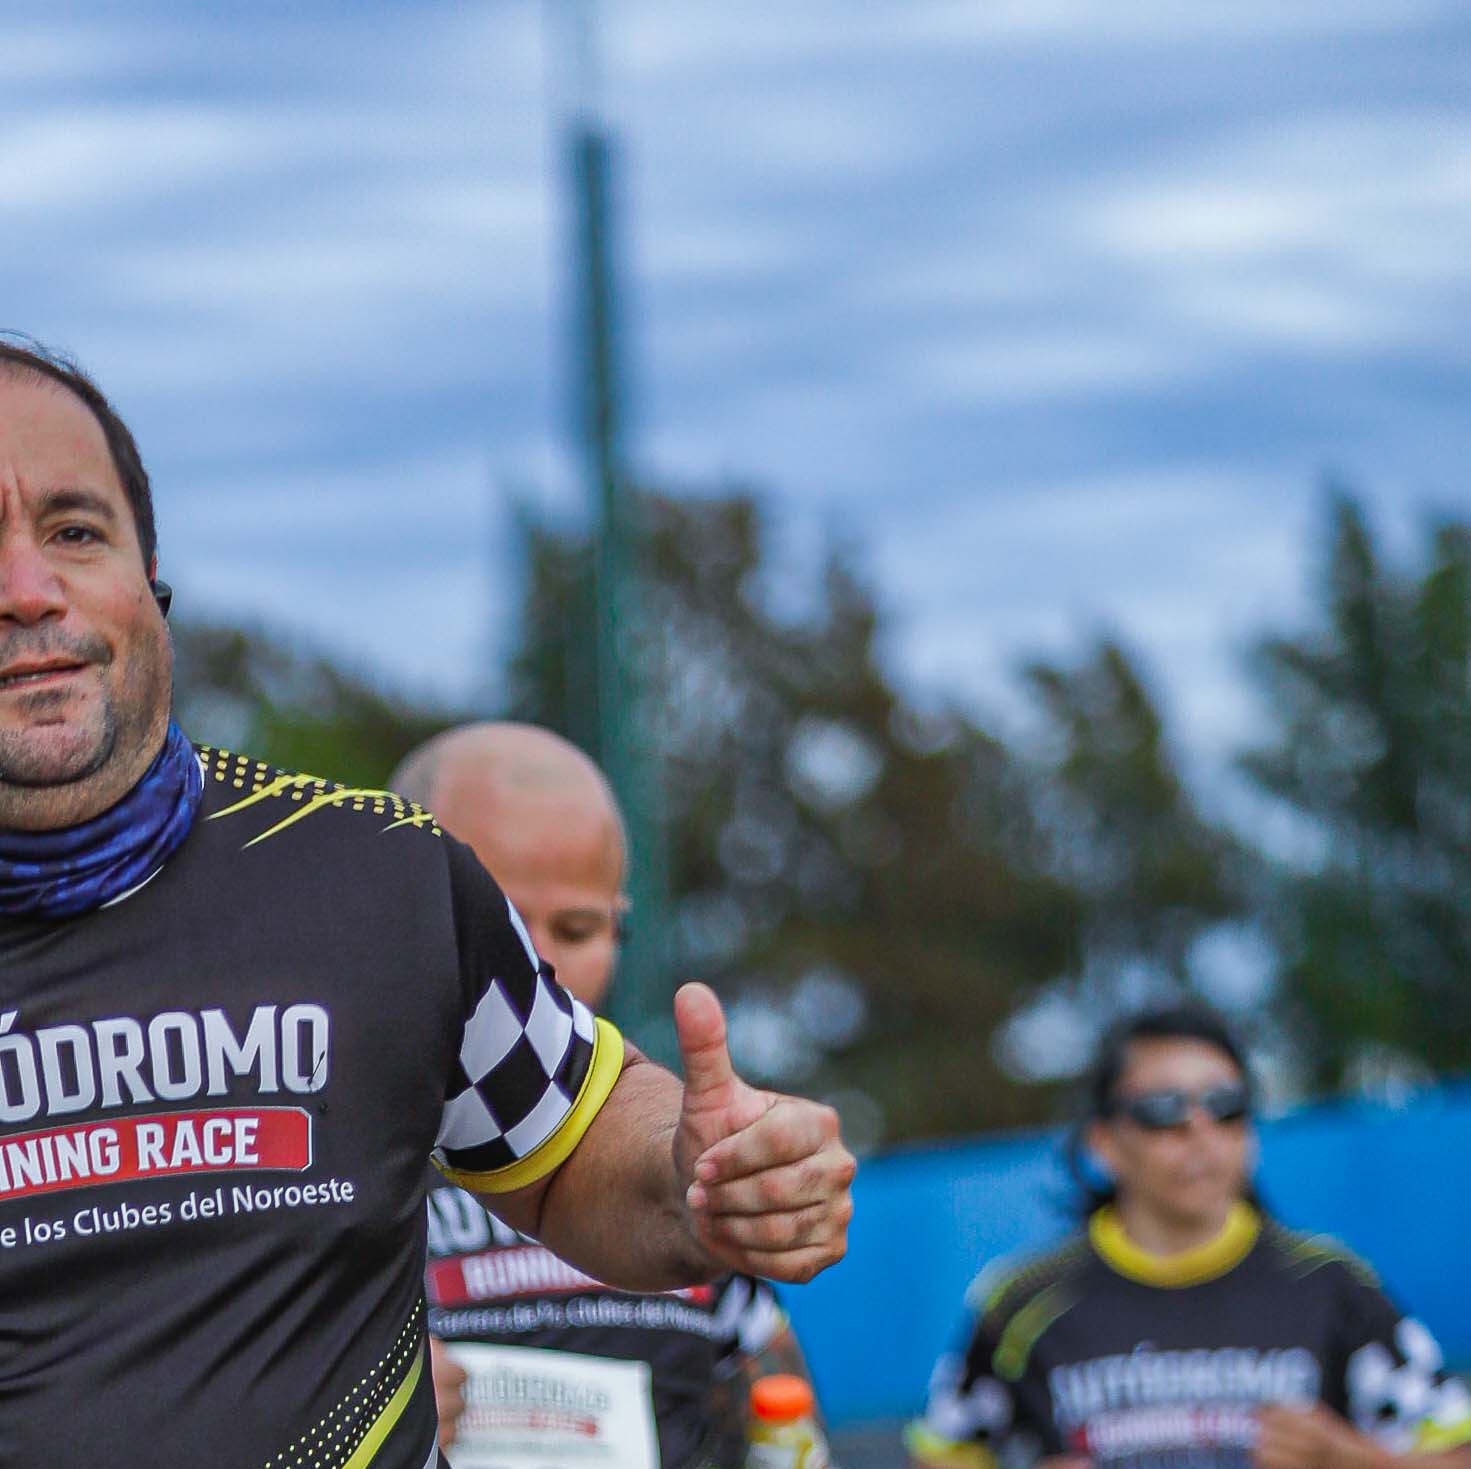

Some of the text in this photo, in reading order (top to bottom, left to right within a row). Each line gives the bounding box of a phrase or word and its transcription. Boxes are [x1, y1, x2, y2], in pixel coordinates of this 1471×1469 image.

[135, 1117, 260, 1171] RACE
[24, 1217, 67, 1246] los
[73, 1200, 173, 1236] Clubes
[181, 1192, 223, 1222] del
[232, 1178, 354, 1215] Noroeste
